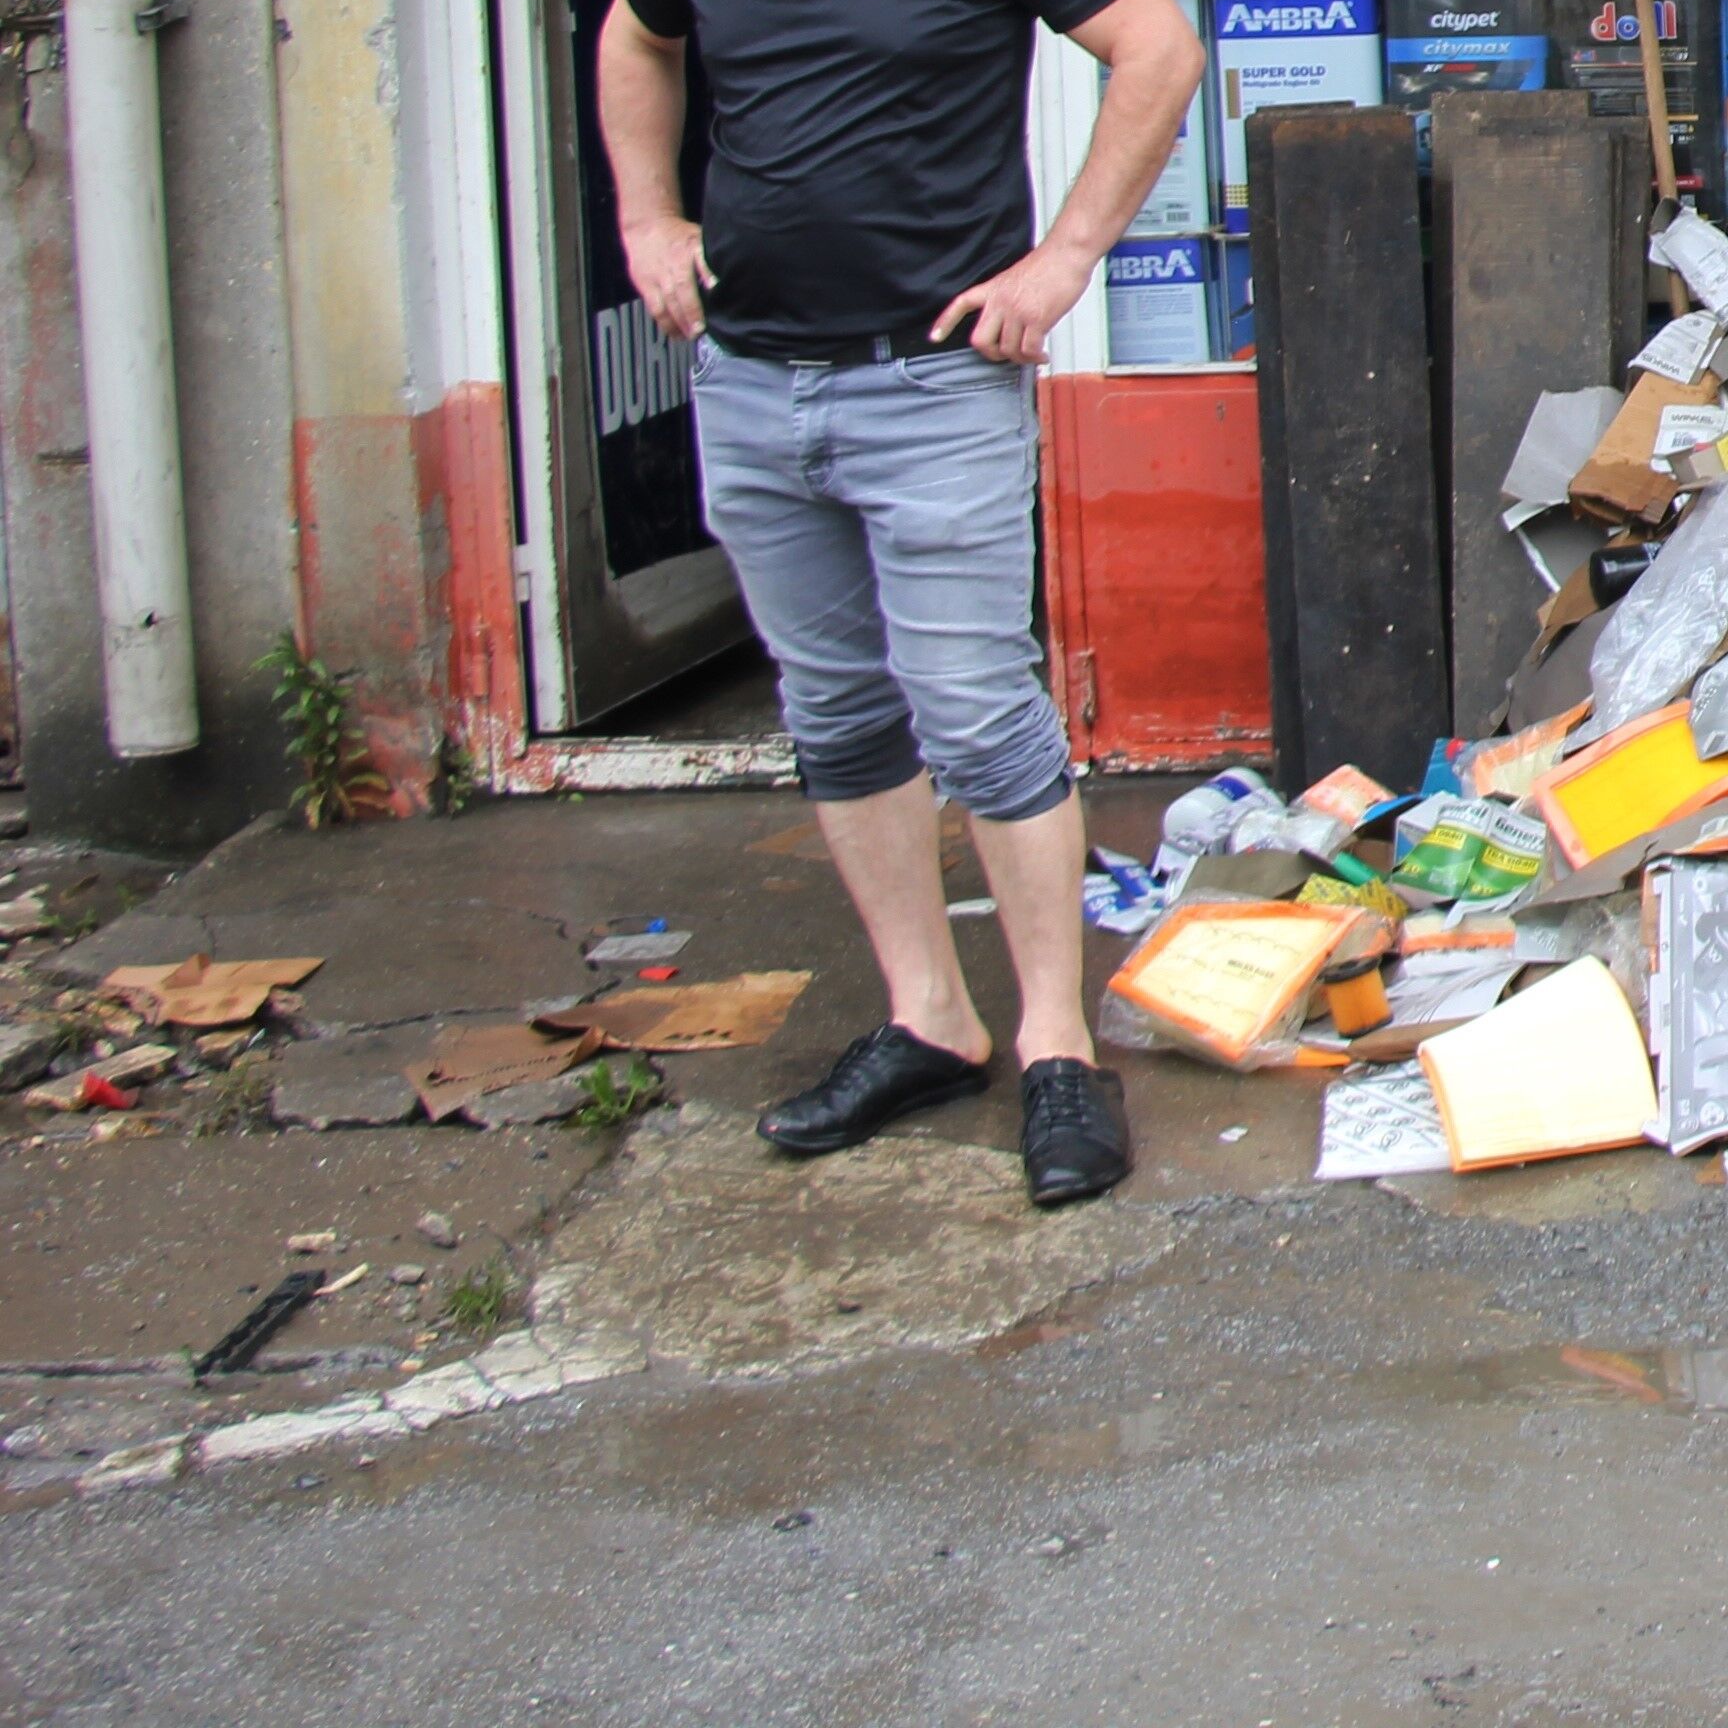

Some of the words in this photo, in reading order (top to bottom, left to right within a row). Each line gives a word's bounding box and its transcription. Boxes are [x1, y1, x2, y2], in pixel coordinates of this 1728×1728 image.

[1222, 0, 1357, 33] AMBRA
[1430, 10, 1500, 32] citypet
[1422, 39, 1510, 60] citymax
[1242, 66, 1287, 79] SUPER
[1290, 66, 1326, 78] GOLD
